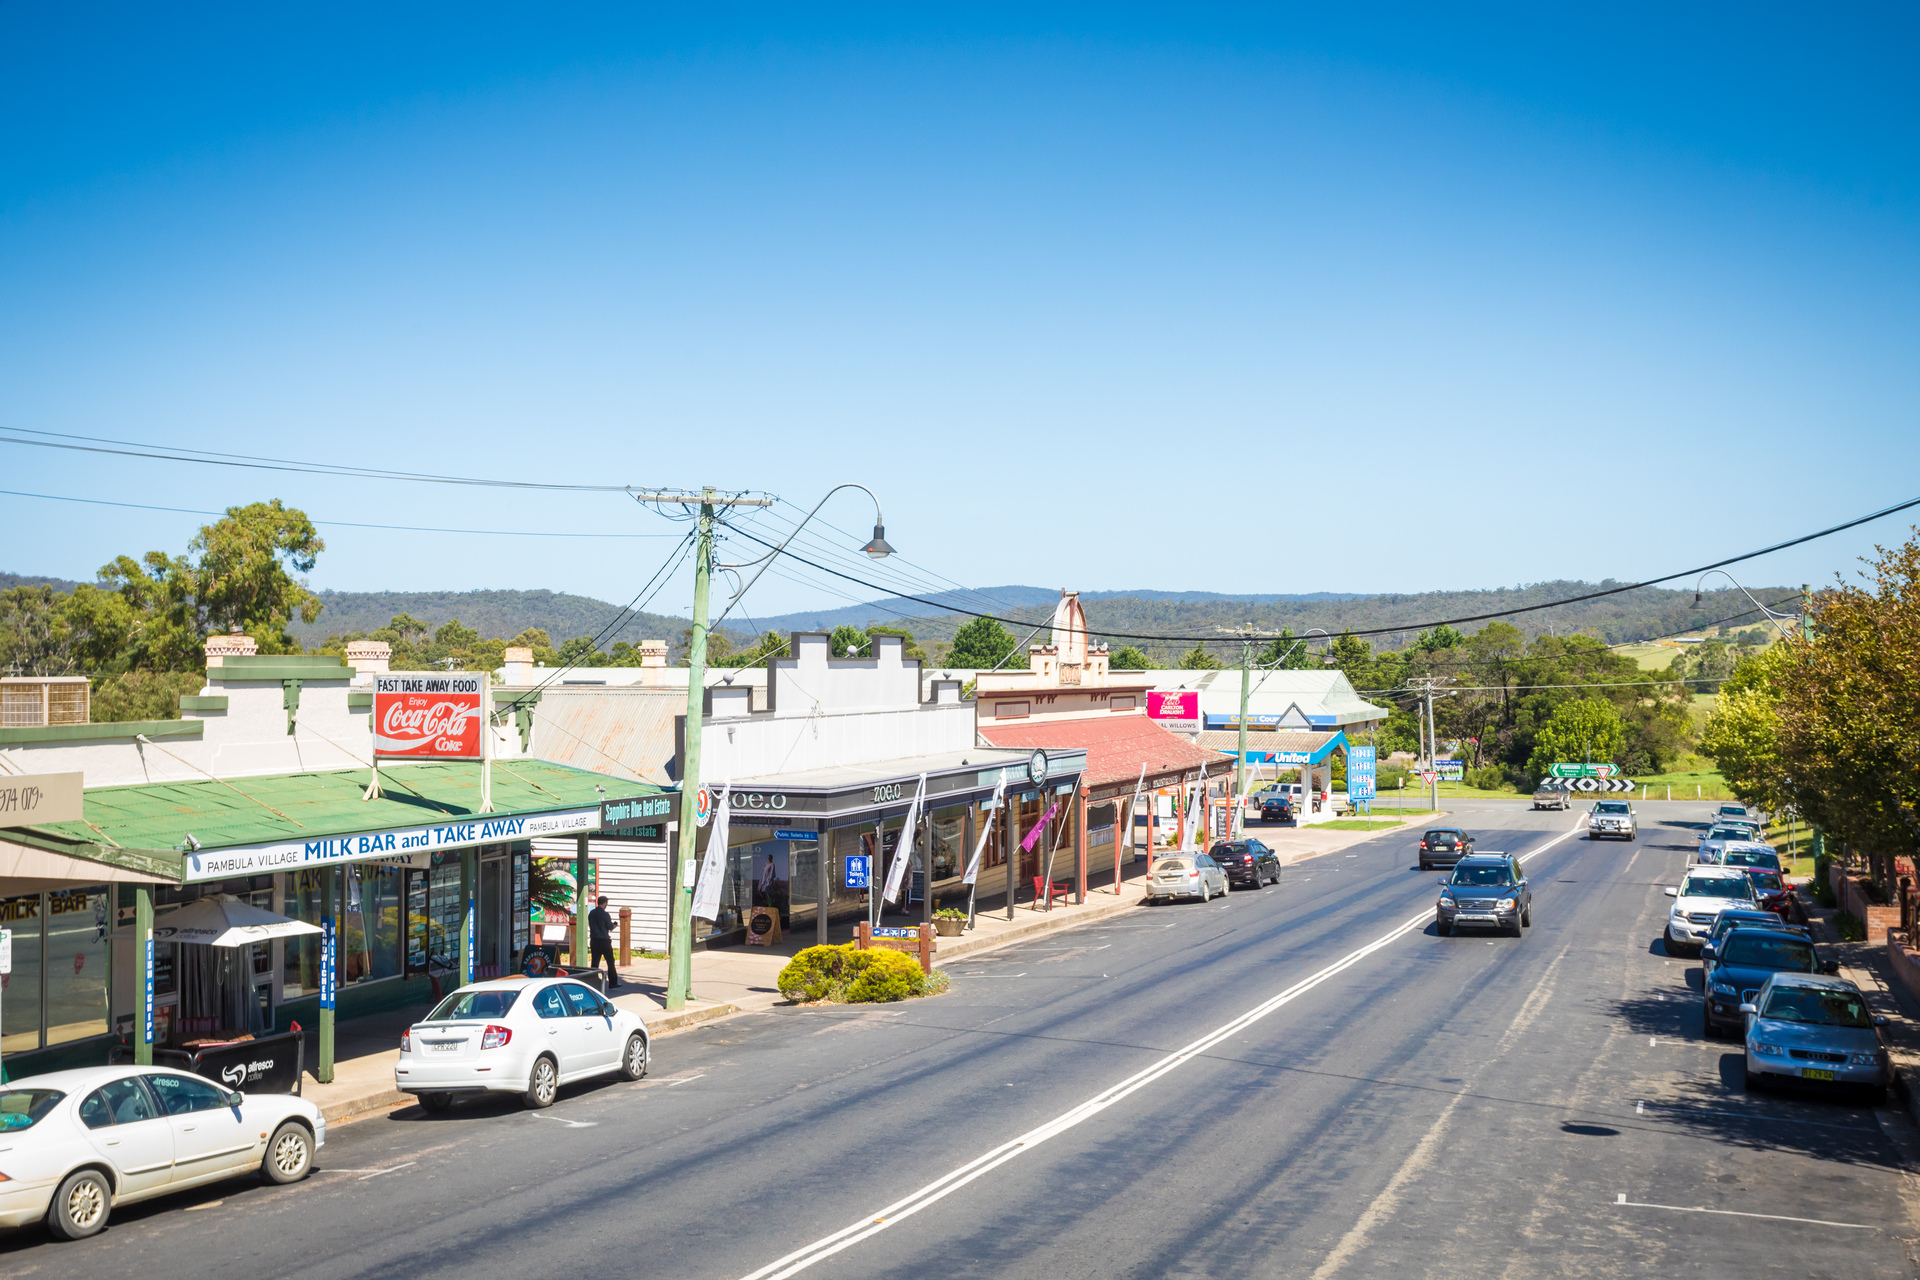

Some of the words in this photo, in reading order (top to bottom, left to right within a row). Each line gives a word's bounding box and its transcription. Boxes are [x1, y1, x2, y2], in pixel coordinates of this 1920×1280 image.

[378, 680, 398, 692] FAST
[401, 680, 423, 692] TAKE
[426, 680, 450, 692] AWAY
[453, 680, 477, 692] FOOD
[409, 697, 427, 706] Enjoy
[383, 702, 470, 736] Coca-Cola
[1259, 715, 1280, 723] COUR
[435, 737, 463, 752] Coke
[1274, 753, 1311, 764] United
[874, 783, 901, 802] zoe.o
[728, 792, 787, 809] oe.o
[605, 804, 630, 825] Sapphire
[631, 801, 642, 818] Blue
[643, 800, 654, 816] Real
[655, 798, 671, 815] Estate
[207, 857, 253, 873] PAMBULA
[258, 851, 298, 867] VILLAGE
[305, 838, 353, 861] MILK
[358, 834, 397, 854] BAR
[401, 829, 429, 848] and
[434, 825, 476, 844] TAKE
[480, 818, 526, 838] AWAY
[529, 821, 559, 832] PAMBULA
[561, 817, 587, 828] VILLAGE
[287, 868, 321, 894] TAK
[0, 899, 39, 922] MILK
[50, 892, 88, 916] BAR
[180, 927, 218, 935] alfresco
[320, 922, 328, 1001] SANDWICHES
[147, 981, 152, 992] &
[569, 993, 584, 1002] fresco
[248, 1060, 274, 1072] alfresco
